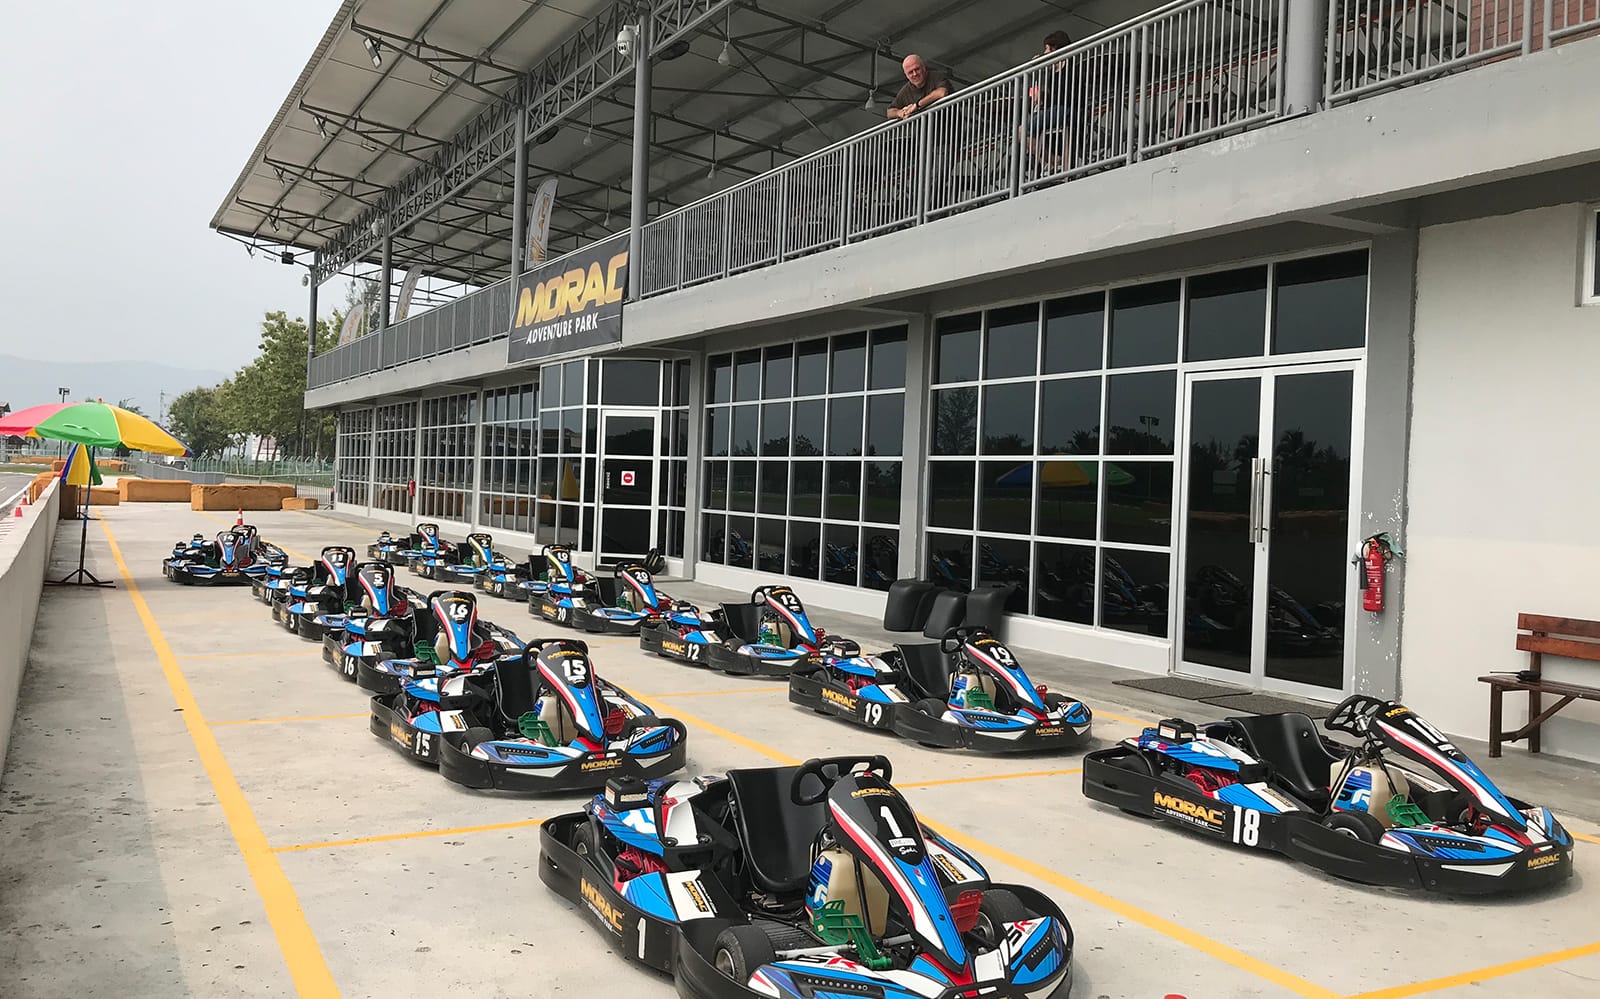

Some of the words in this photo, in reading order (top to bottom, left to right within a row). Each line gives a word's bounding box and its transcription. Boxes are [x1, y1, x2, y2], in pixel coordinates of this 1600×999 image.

[515, 251, 629, 329] MORAC
[525, 319, 572, 345] ADVENTURE
[575, 312, 599, 334] PARK
[331, 554, 344, 562] 11
[374, 573, 383, 583] 5
[634, 571, 649, 581] 20
[449, 603, 468, 616] 16
[780, 594, 798, 606] 12
[687, 643, 700, 661] 12
[989, 646, 1011, 662] 19
[343, 655, 355, 676] 16
[561, 660, 587, 677] 15
[822, 687, 857, 710] MORAC
[864, 702, 883, 726] 19
[415, 731, 431, 757] 15
[580, 758, 623, 770] MORAC
[1153, 791, 1223, 825] MORAC
[880, 806, 903, 838] 1
[1233, 805, 1261, 847] 18
[1527, 853, 1561, 868] MORAC
[580, 878, 625, 932] MORAC
[684, 881, 709, 912] MORAC
[637, 917, 647, 960] 1
